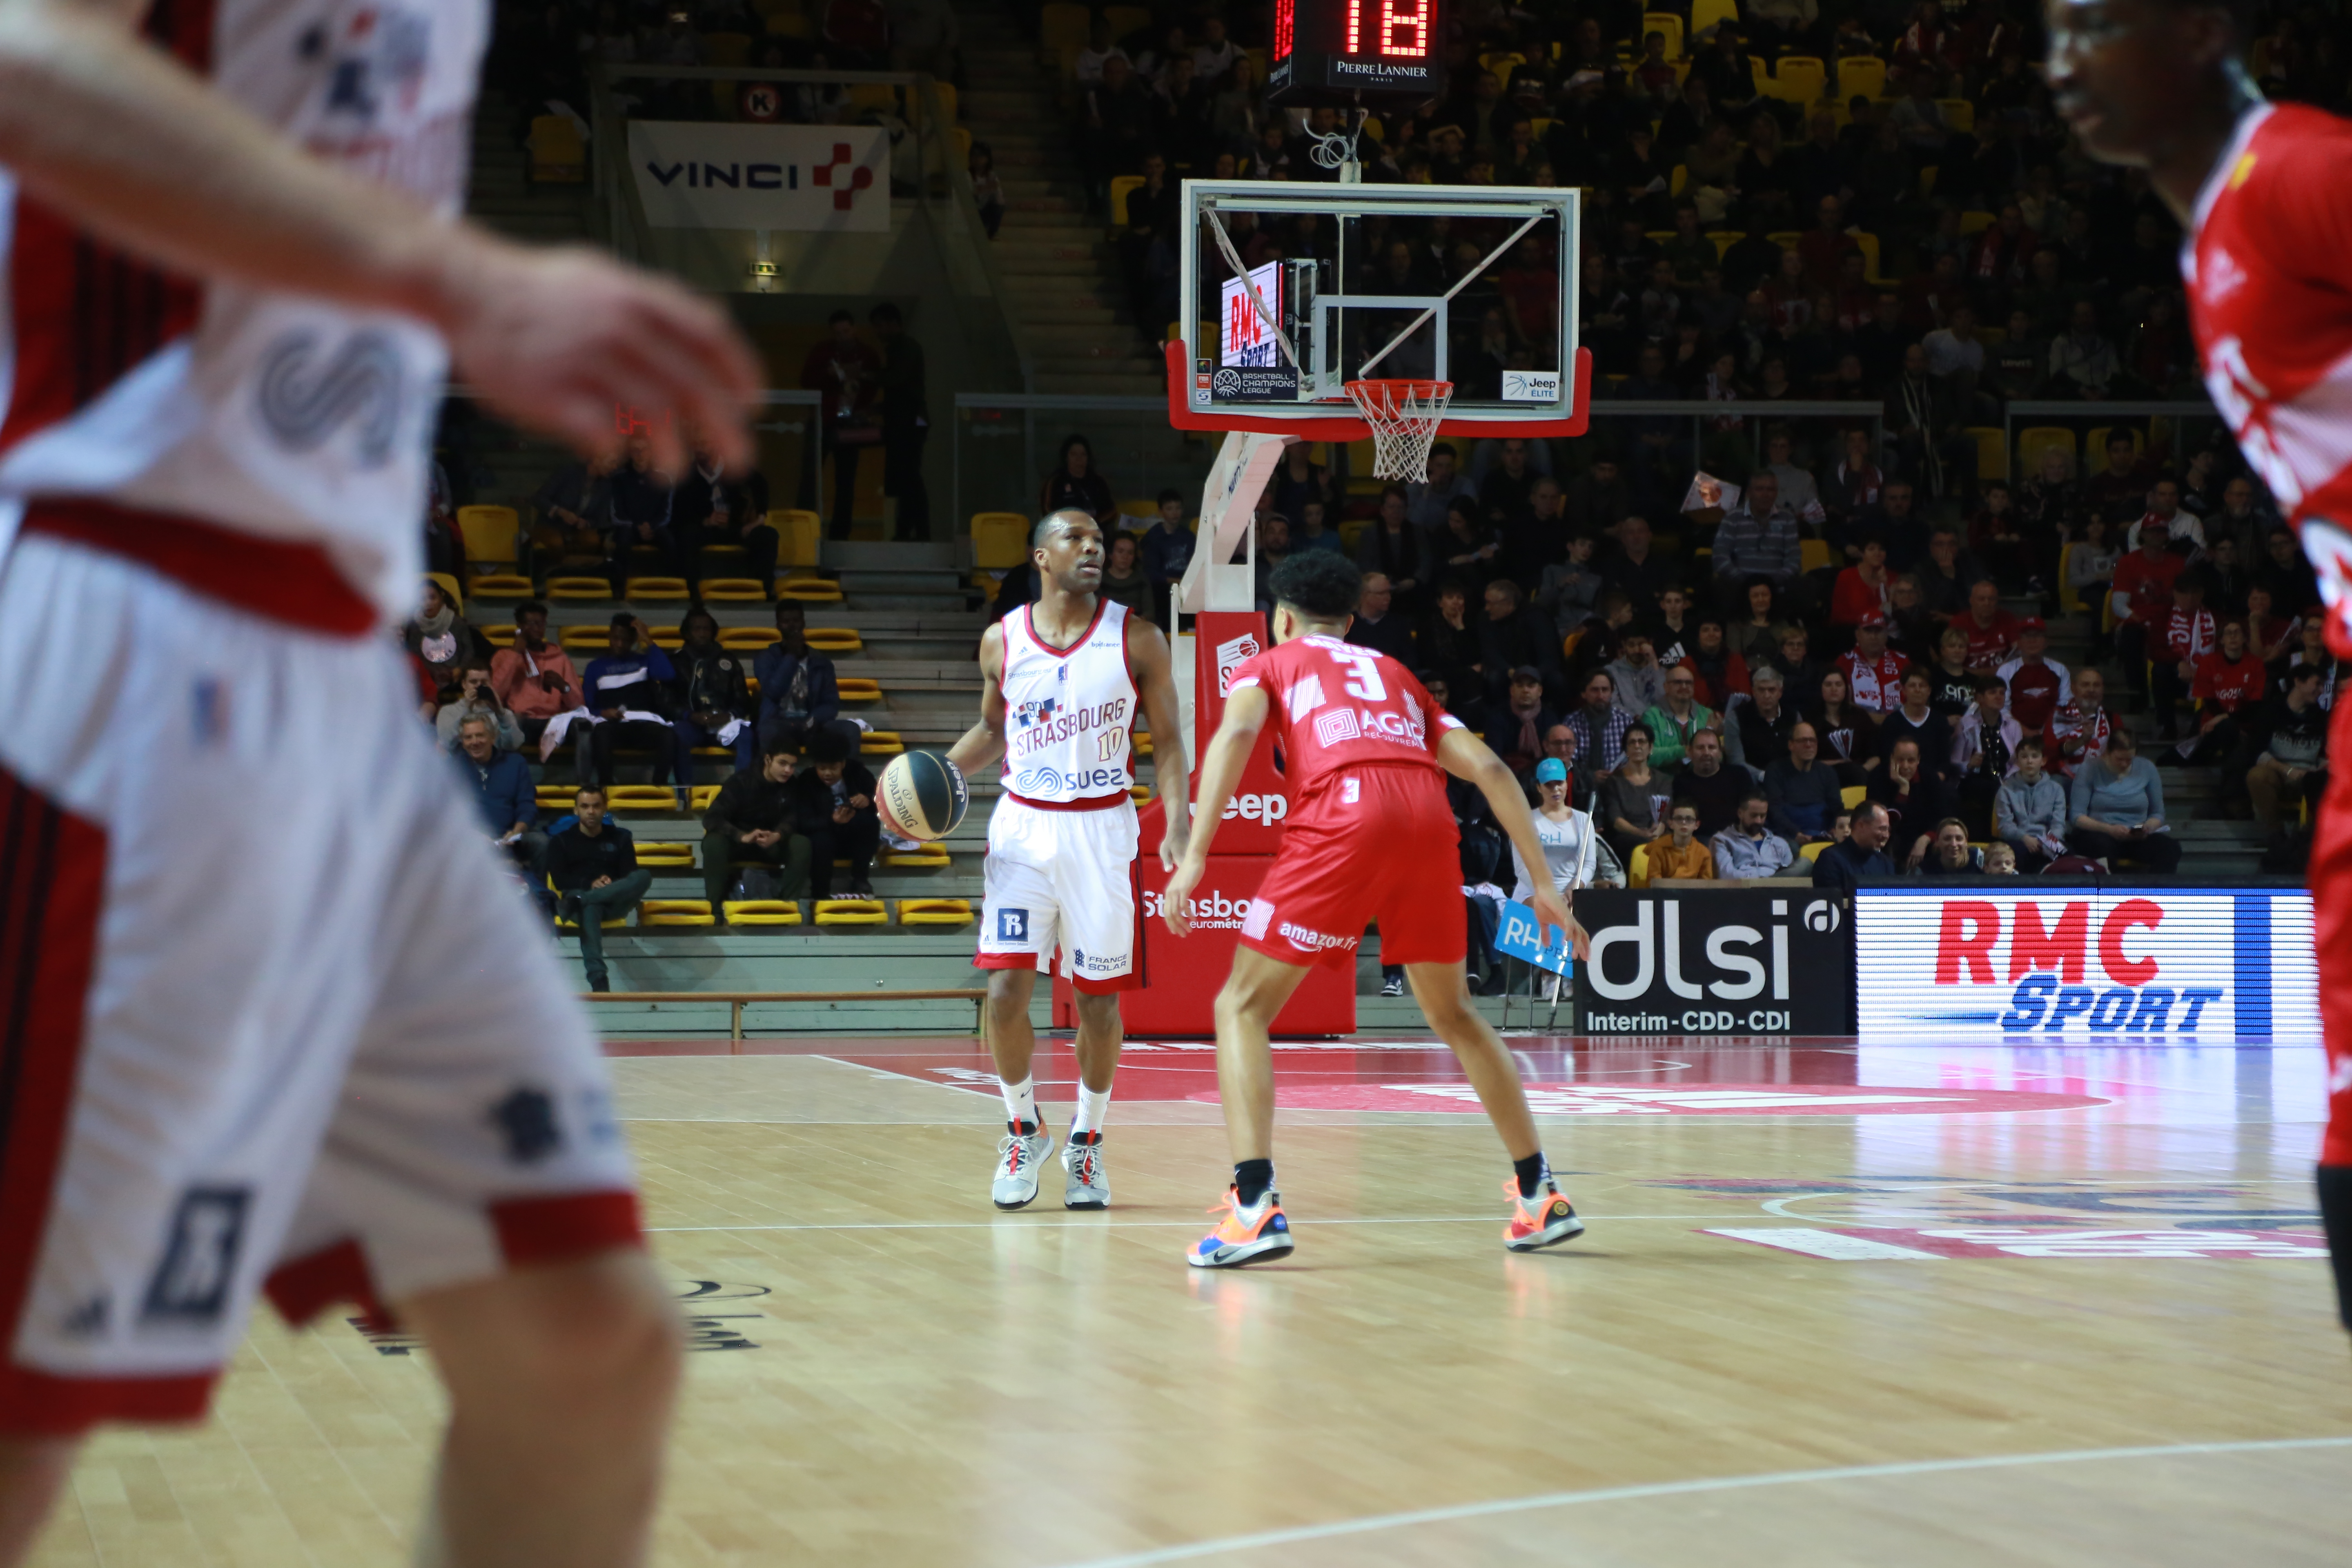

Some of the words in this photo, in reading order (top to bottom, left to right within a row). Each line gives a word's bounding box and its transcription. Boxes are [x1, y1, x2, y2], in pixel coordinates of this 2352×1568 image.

[1337, 60, 1376, 74] PIERRE
[1378, 63, 1428, 78] LANNIER
[753, 94, 768, 112] K
[647, 162, 797, 190] VINCI
[1231, 285, 1264, 352] RMC
[1529, 377, 1556, 389] Jeep
[1531, 389, 1555, 397] ÉLITE
[1303, 638, 1384, 658] HAYES
[1330, 652, 1387, 701] 3
[1017, 698, 1127, 758] STRASBOURG
[1098, 726, 1125, 762] 10
[947, 761, 965, 803] Jeep
[1065, 768, 1125, 791] suez
[1343, 777, 1361, 804] 3
[887, 766, 919, 829] SPALDING
[1504, 916, 1542, 951] RH
[1935, 898, 2164, 986] RMC
[1089, 953, 1127, 963] FRANCE
[1586, 899, 1789, 1000] dlsi
[1088, 960, 1126, 971] SOLAR
[2001, 974, 2224, 1032] SPORT
[1588, 1011, 1668, 1031] Interim
[1682, 1011, 1735, 1031] CDD
[1748, 1011, 1791, 1031] CDI
